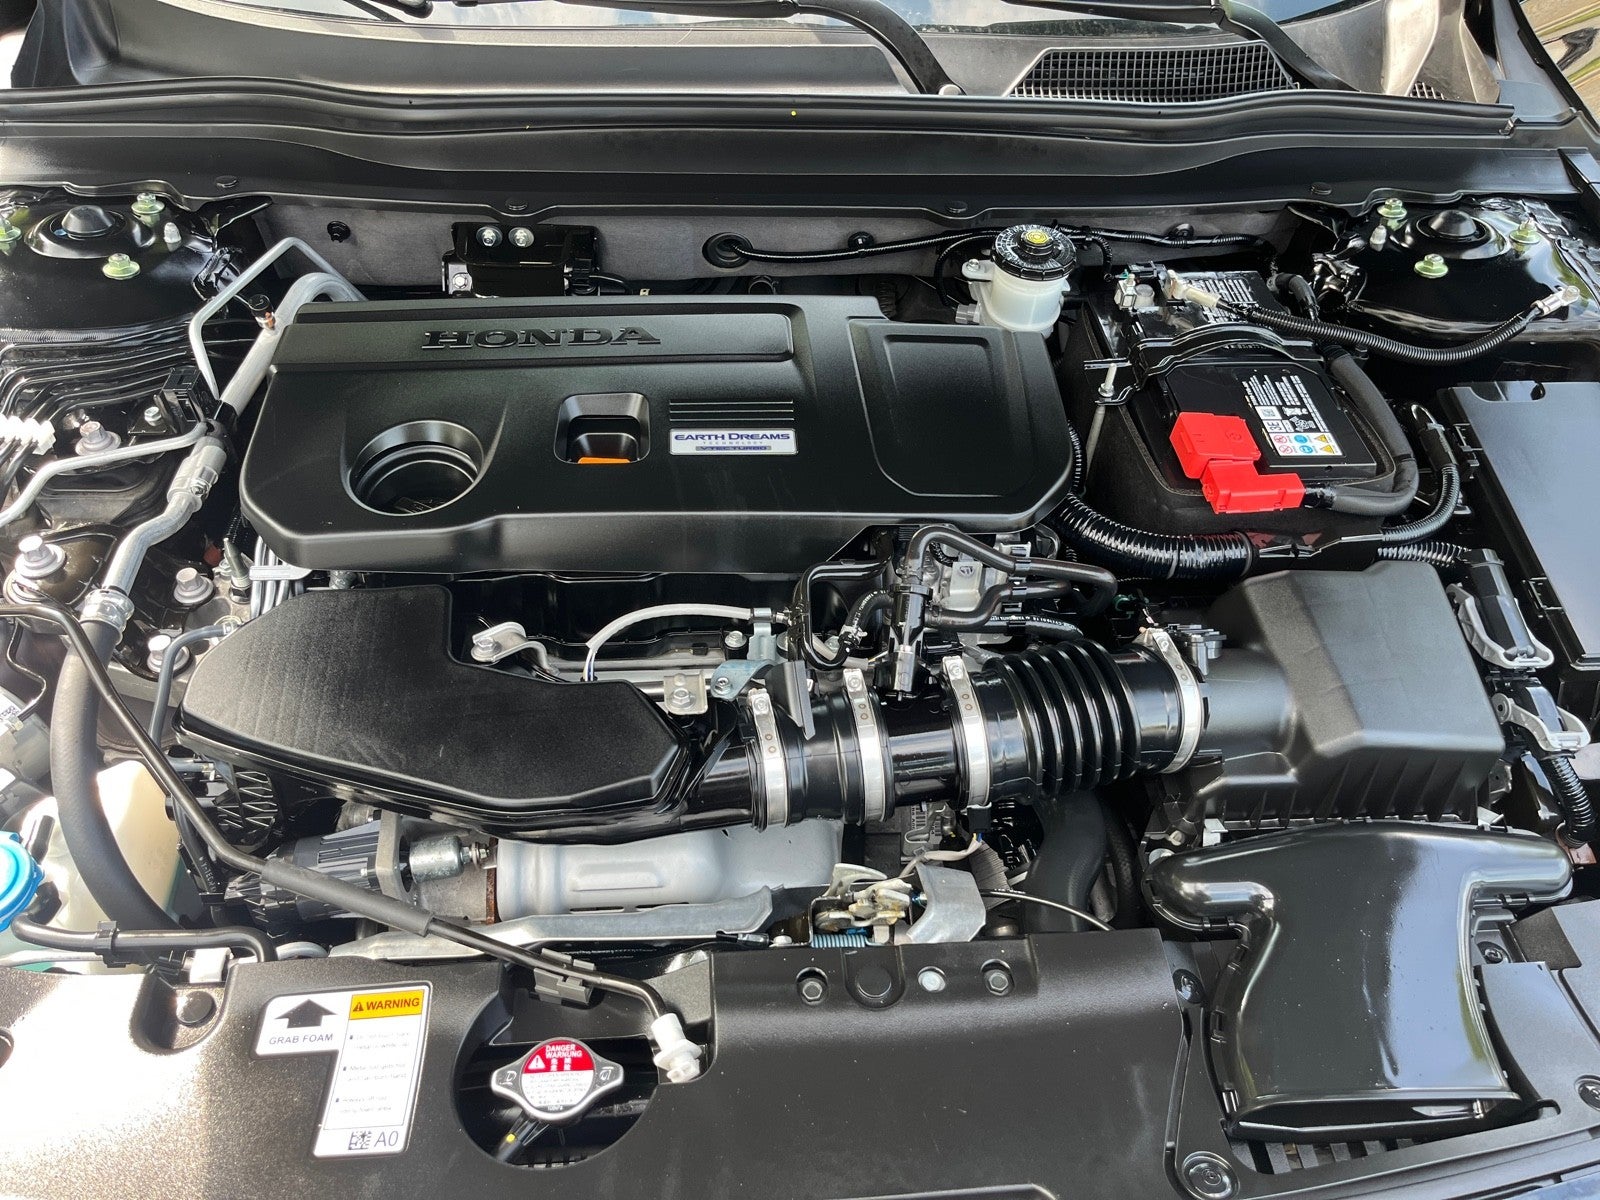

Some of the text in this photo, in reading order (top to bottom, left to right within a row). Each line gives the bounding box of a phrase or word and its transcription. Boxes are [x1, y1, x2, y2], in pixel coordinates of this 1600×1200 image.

[421, 326, 661, 349] HONDA
[728, 432, 790, 441] DREAMS
[366, 997, 420, 1011] WARNING
[269, 1033, 334, 1045] GRAB FOAM
[545, 1043, 576, 1052] DANGER
